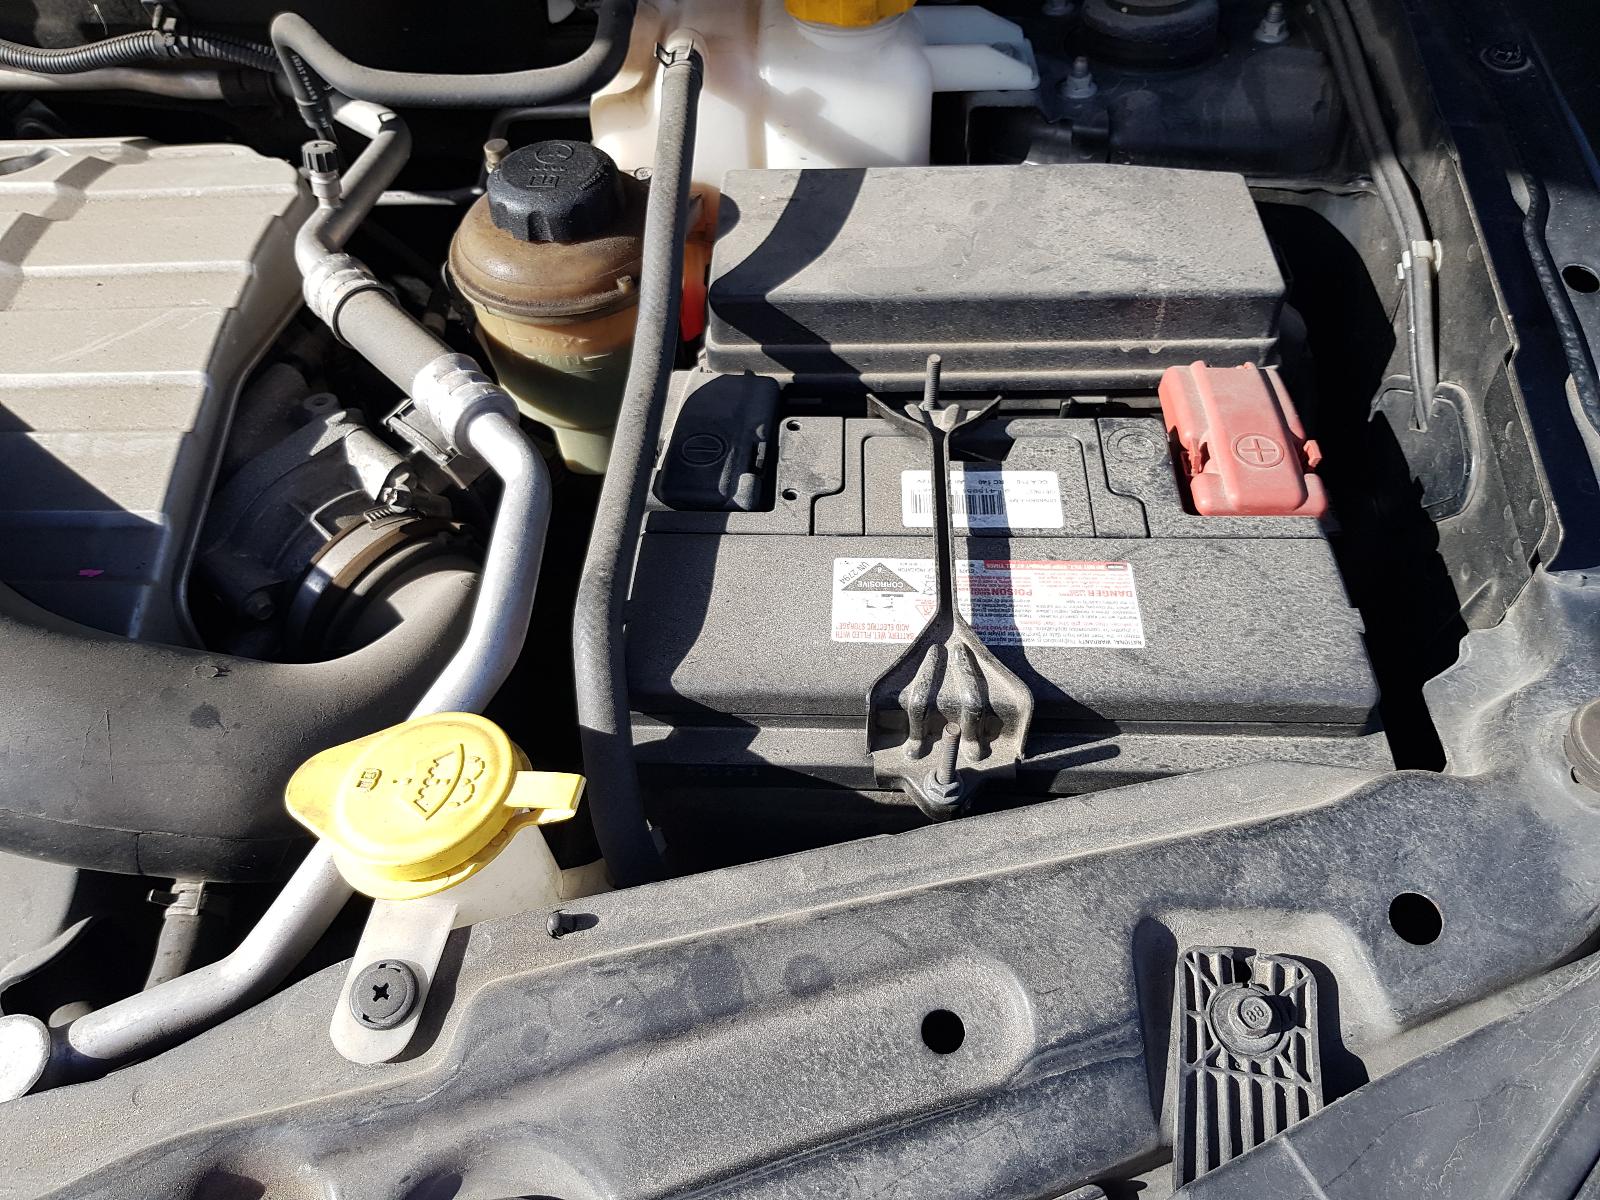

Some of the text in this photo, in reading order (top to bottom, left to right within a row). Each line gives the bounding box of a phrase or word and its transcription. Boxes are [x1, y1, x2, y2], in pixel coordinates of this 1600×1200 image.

[839, 562, 870, 584] UN 2794
[856, 580, 904, 588] CORROSIVE
[1088, 590, 1133, 598] DANGER
[867, 622, 894, 631] ELECTRIC
[836, 630, 850, 638] WITH
